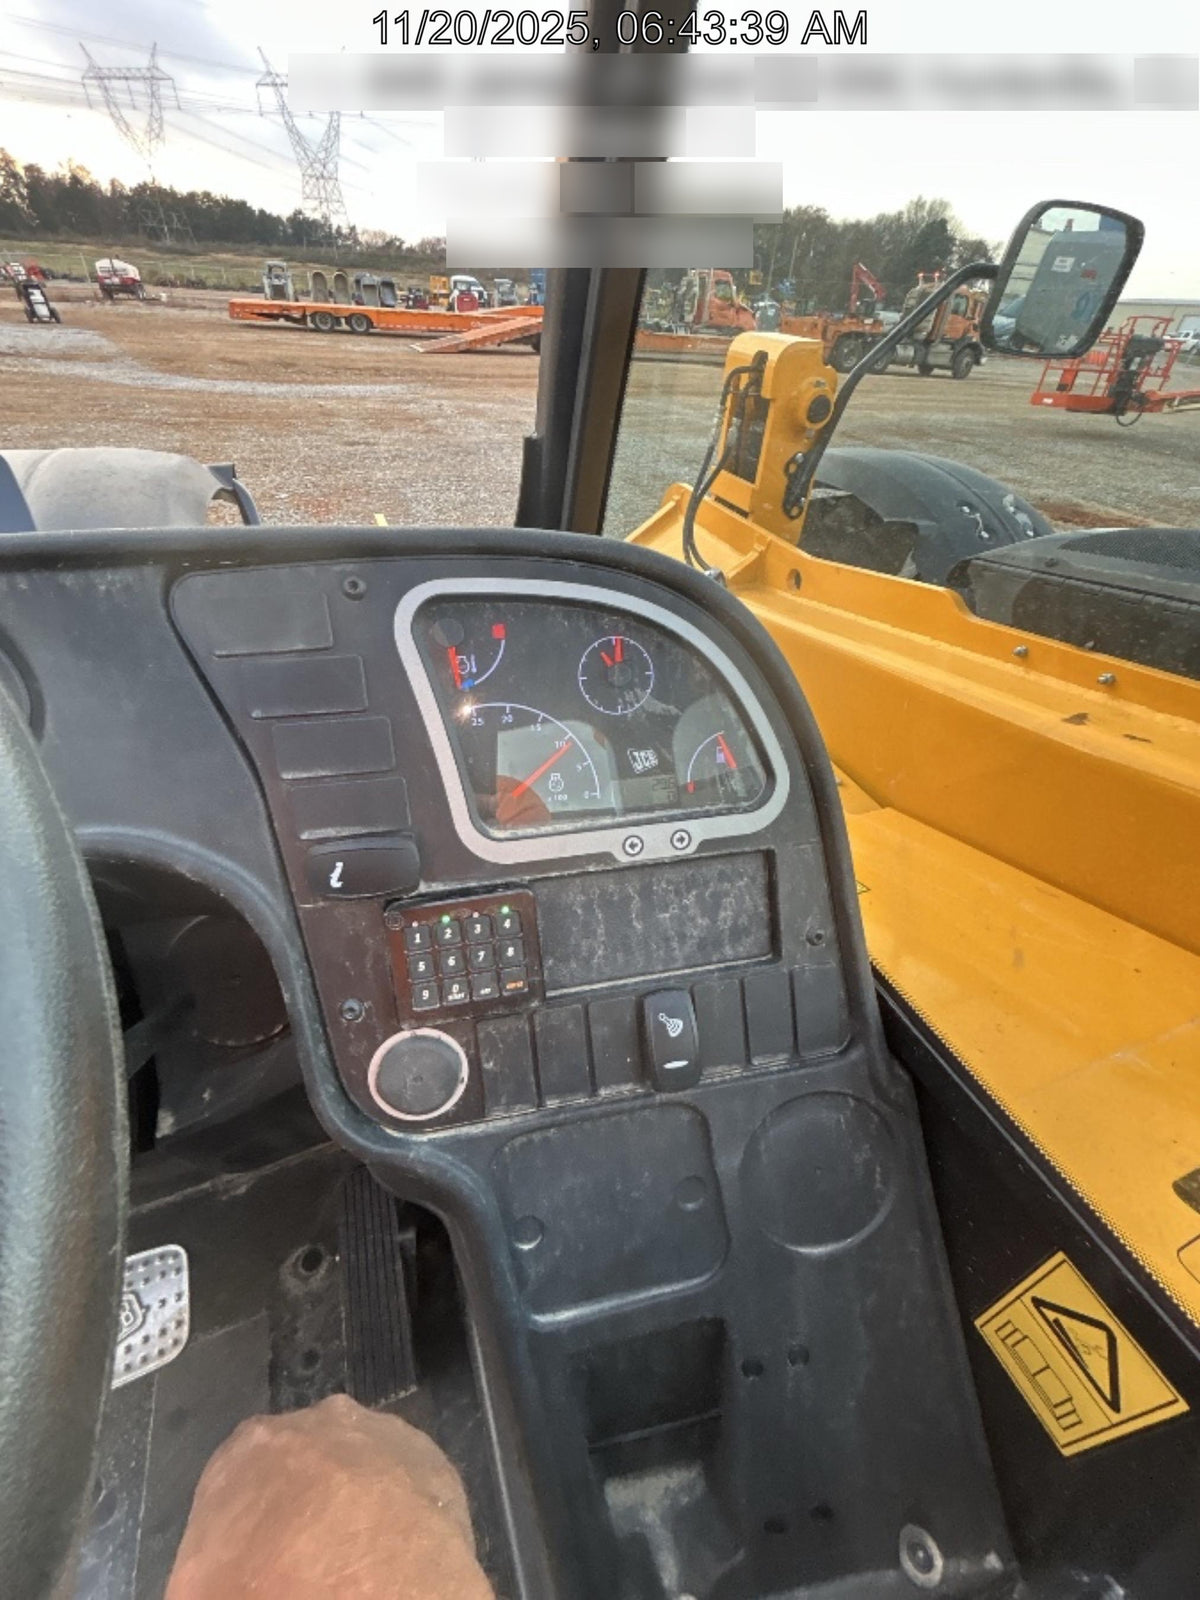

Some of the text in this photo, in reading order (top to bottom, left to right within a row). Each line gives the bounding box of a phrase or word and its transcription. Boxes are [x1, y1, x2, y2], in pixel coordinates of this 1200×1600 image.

[474, 923, 482, 934] 3
[503, 918, 511, 929] 4
[414, 932, 421, 943] 1
[444, 927, 452, 939] 2
[478, 950, 486, 962] 7
[506, 946, 515, 957] 8
[418, 961, 426, 972] 5
[448, 956, 456, 967] 6
[452, 983, 460, 993] 0
[422, 989, 430, 1000] 9
